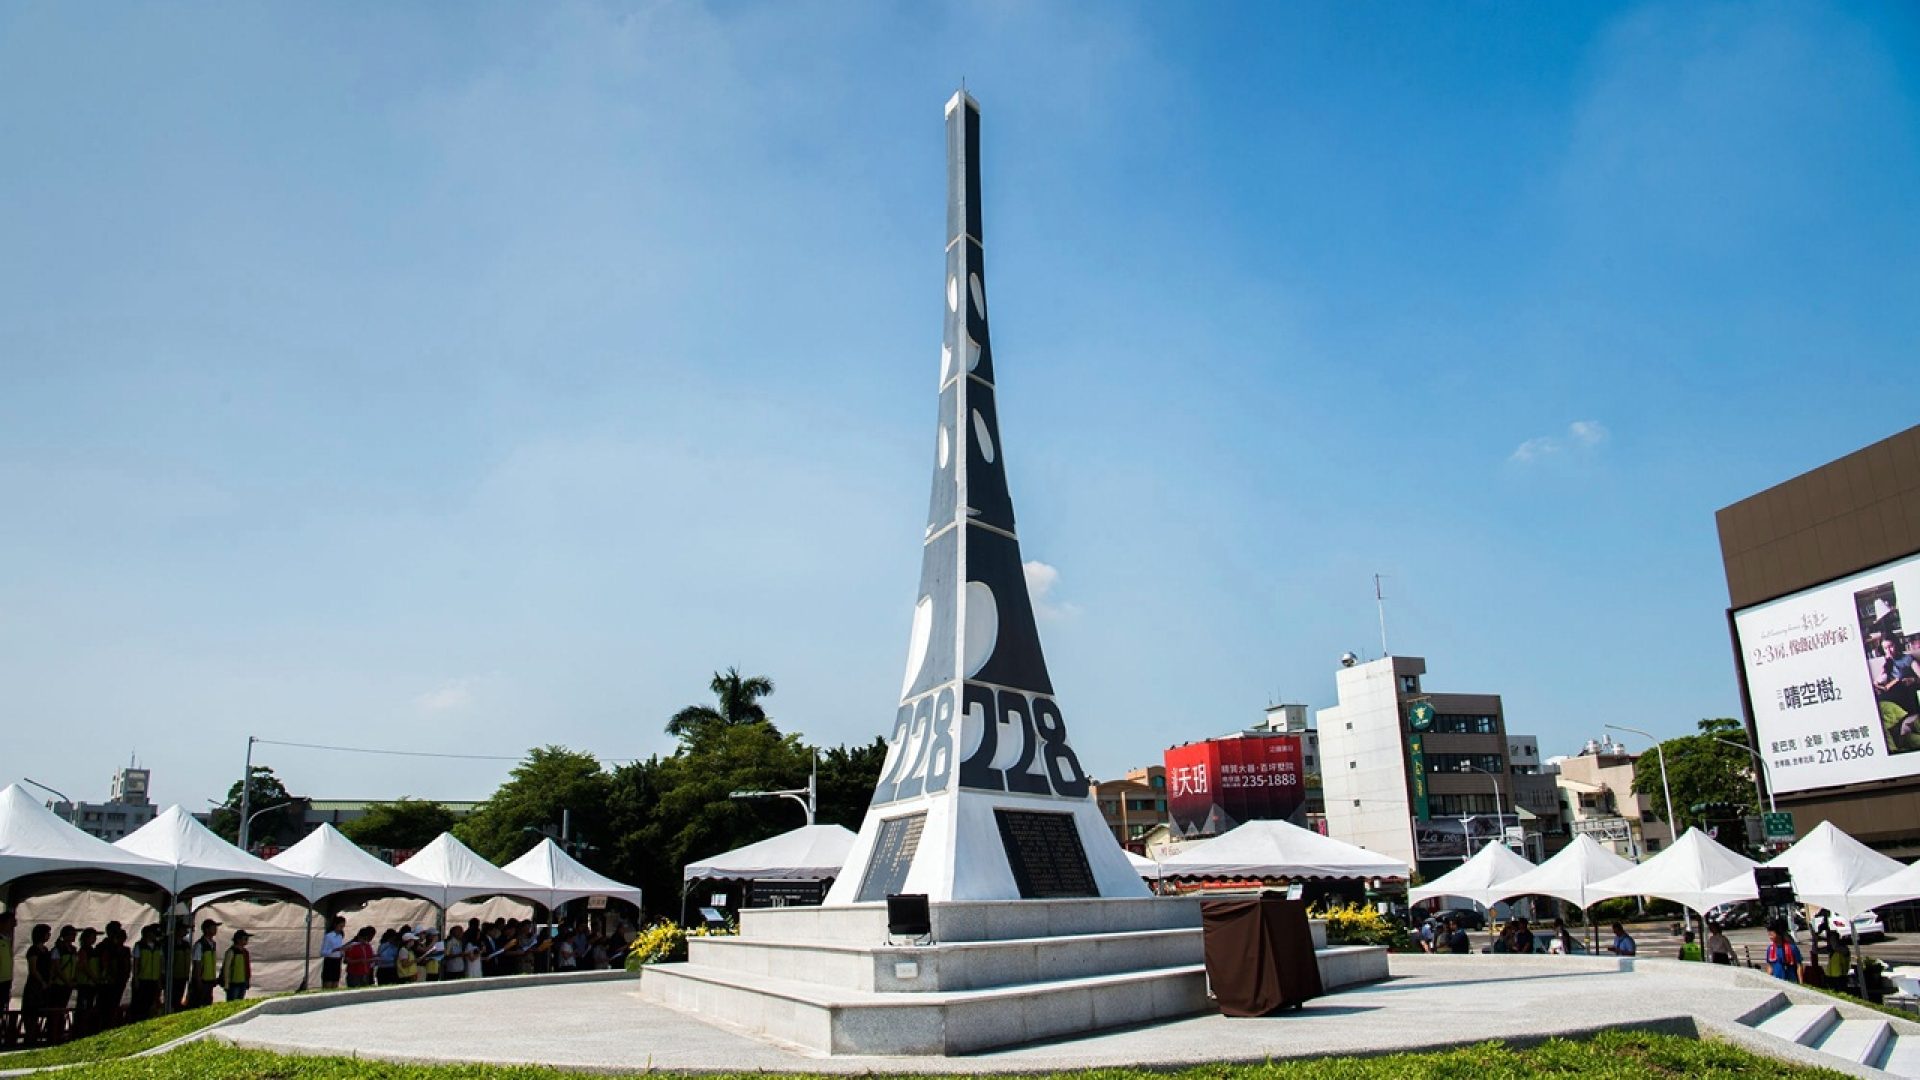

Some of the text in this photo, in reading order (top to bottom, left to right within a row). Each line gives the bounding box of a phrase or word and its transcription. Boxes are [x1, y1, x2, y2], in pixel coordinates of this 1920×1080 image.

[960, 683, 1090, 798] 228
[1817, 741, 1874, 764] 221.6366
[1241, 773, 1296, 788] 235-1888
